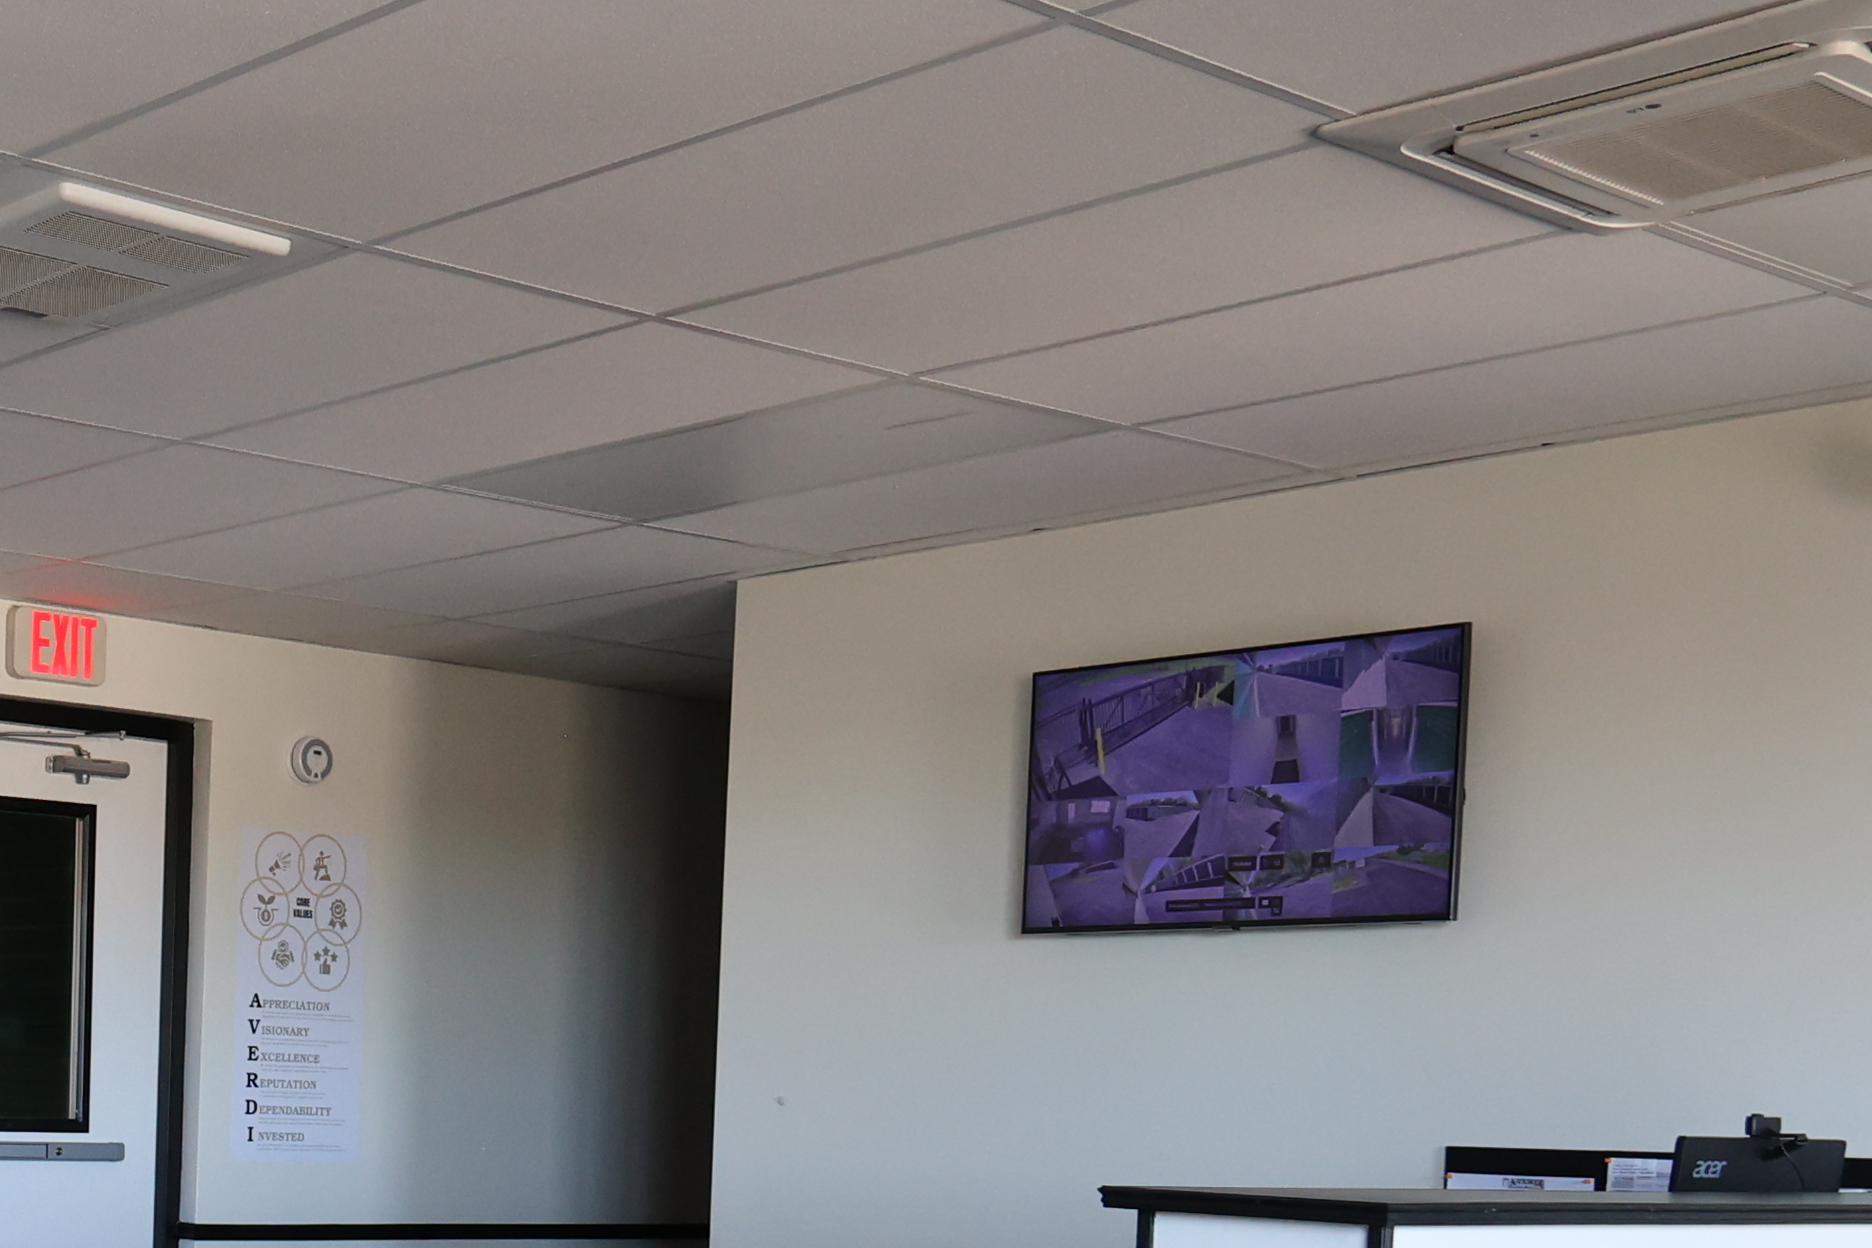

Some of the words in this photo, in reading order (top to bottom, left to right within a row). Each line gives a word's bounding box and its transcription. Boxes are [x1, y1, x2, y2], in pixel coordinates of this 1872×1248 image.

[31, 611, 97, 680] EXIT
[296, 897, 310, 907] CORE
[293, 908, 313, 919] VALUES
[249, 993, 330, 1012] APPRECIATION
[248, 1019, 310, 1037] VISIONARY
[247, 1046, 320, 1064] EXCELLENCE
[246, 1072, 317, 1090] REPUTATION
[245, 1099, 332, 1117] DEPENDABILITY
[247, 1127, 305, 1142] INVESTED
[1692, 1160, 1727, 1178] acer
